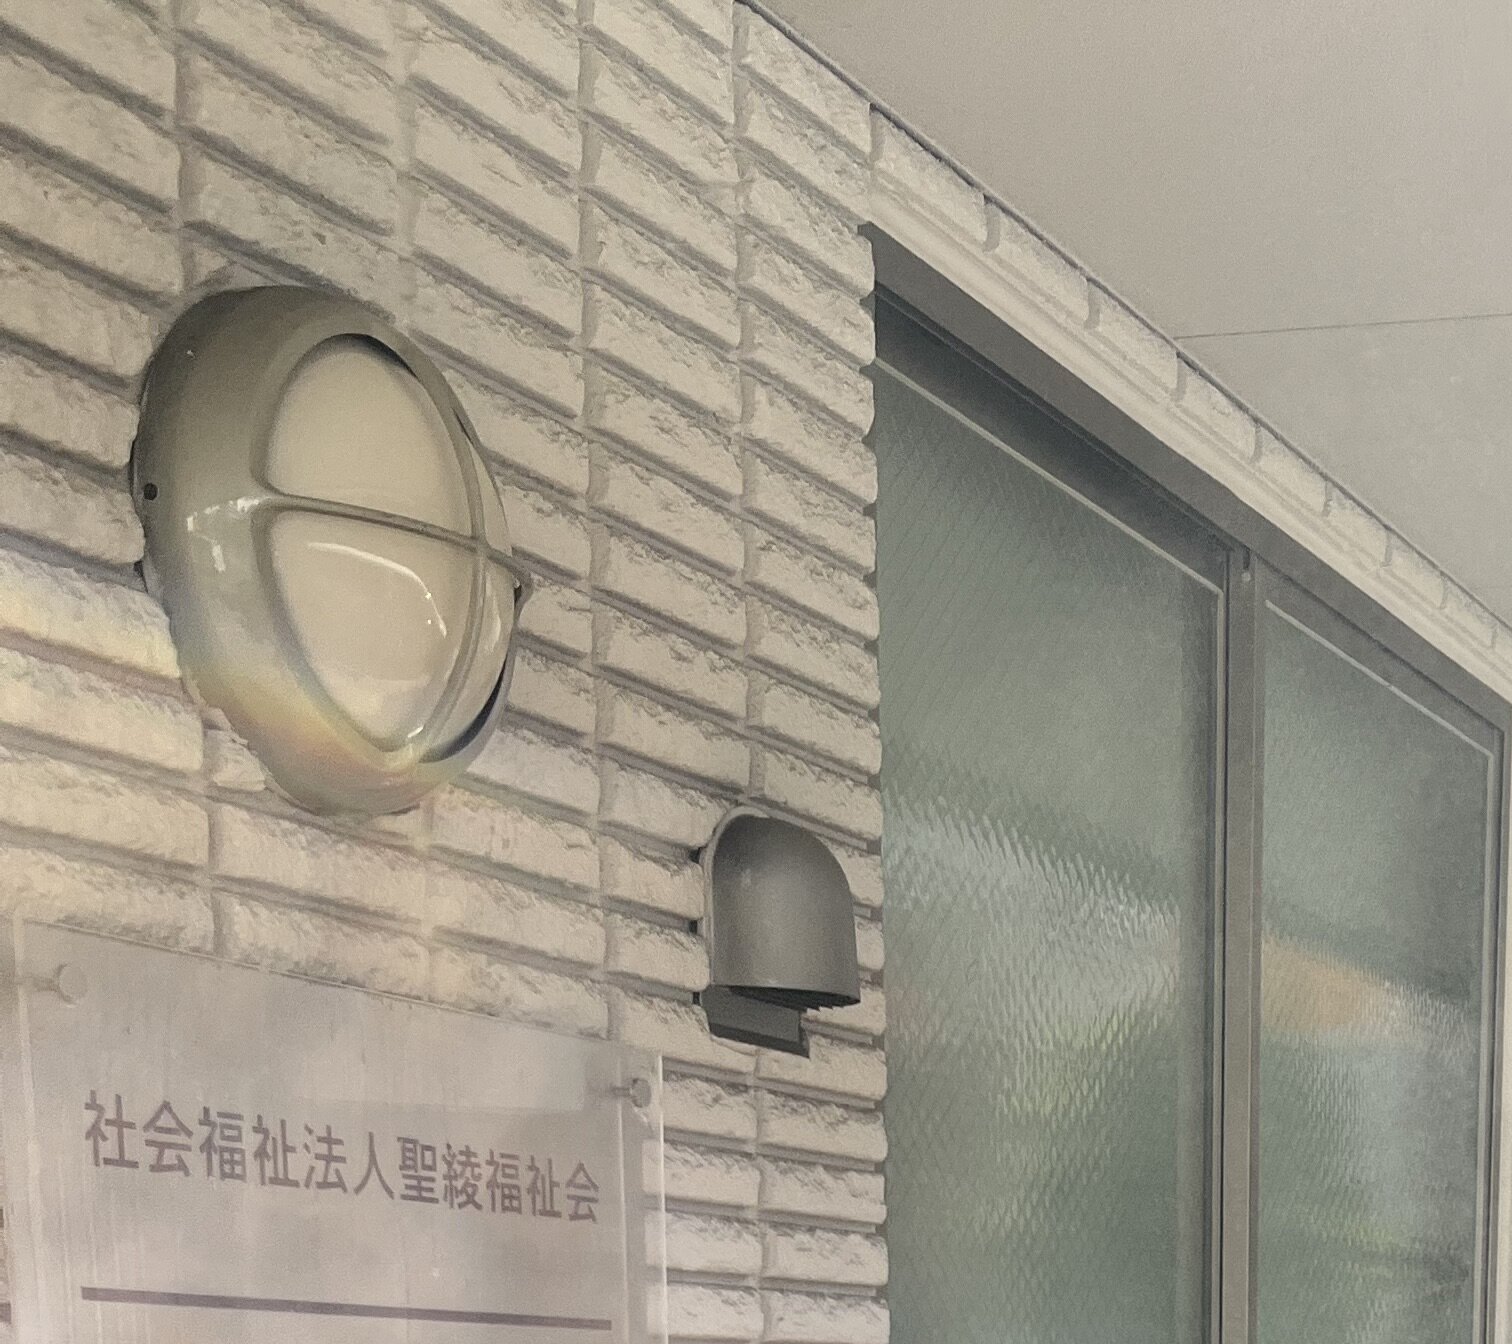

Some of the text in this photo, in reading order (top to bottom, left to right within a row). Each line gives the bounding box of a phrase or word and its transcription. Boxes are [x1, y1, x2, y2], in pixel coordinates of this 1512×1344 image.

[83, 1089, 600, 1223] 社会福祉法人聖綾福祉会
